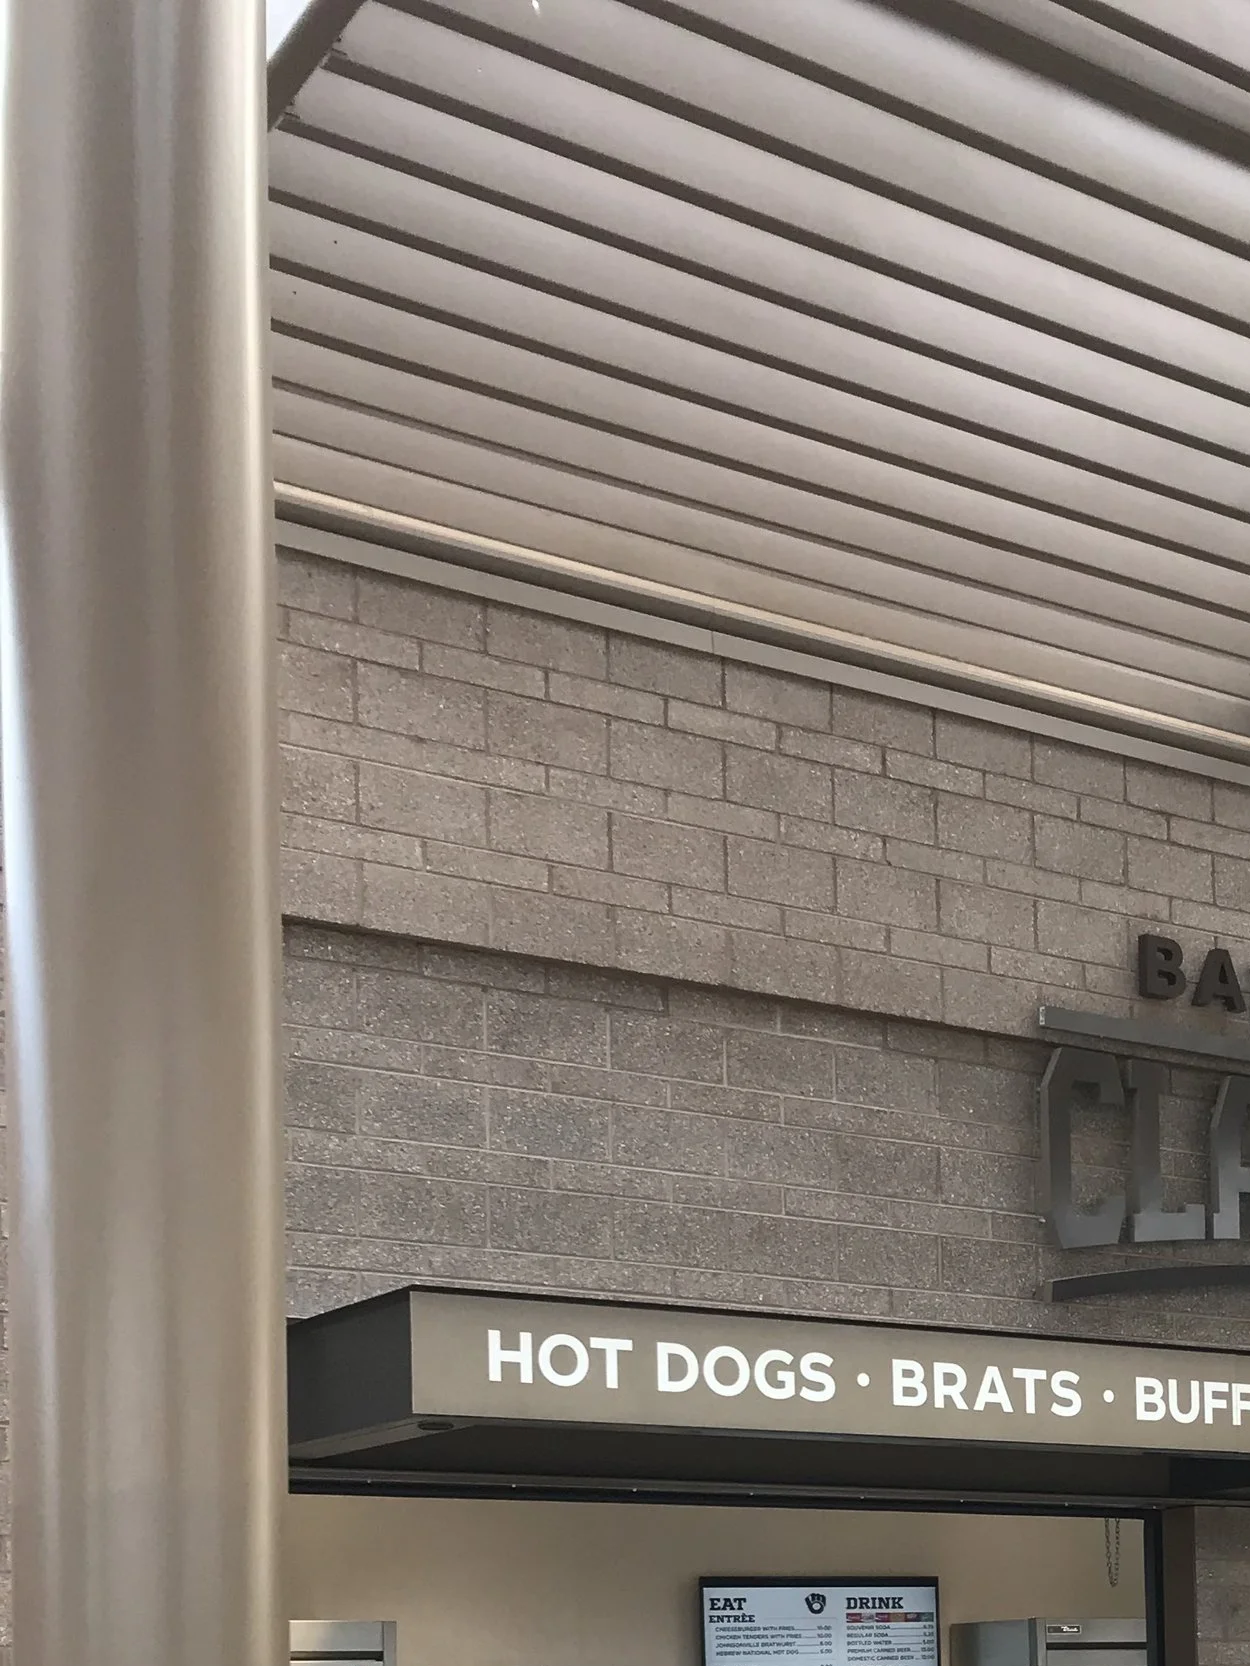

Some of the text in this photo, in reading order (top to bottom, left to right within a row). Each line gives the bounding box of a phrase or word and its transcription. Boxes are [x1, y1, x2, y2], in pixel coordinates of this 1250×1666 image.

[487, 1329, 633, 1389] HOT
[656, 1341, 836, 1402] DOGS
[892, 1358, 1082, 1417] BRATS
[709, 1598, 746, 1611] EAT
[846, 1596, 904, 1610] DRINK
